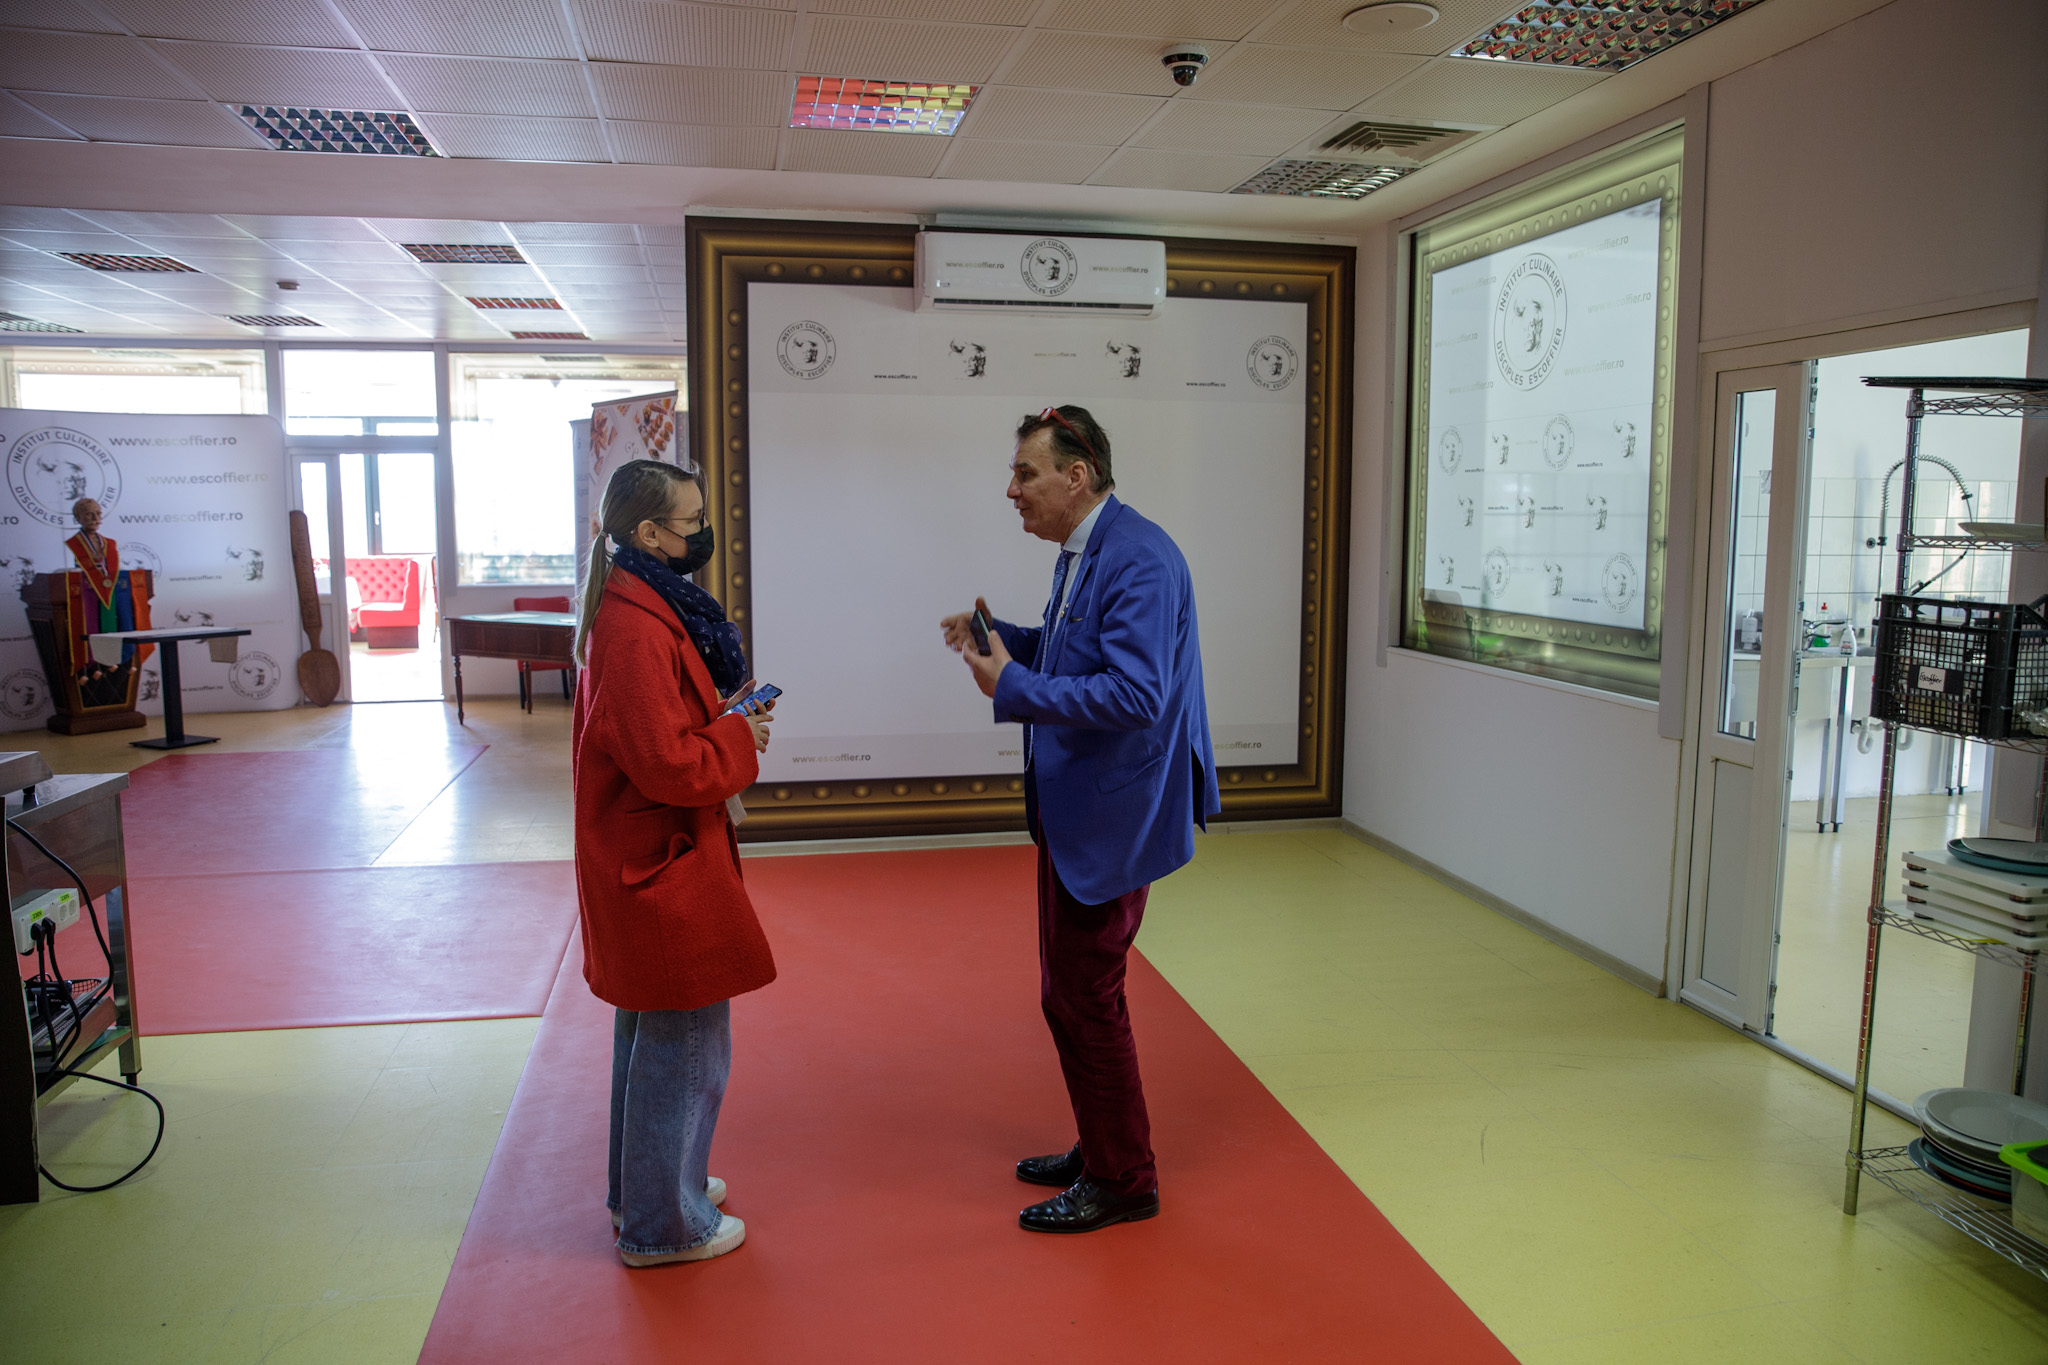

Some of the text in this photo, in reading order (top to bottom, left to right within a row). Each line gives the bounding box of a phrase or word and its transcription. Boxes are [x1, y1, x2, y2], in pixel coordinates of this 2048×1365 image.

[1025, 241, 1074, 261] INSTITUT CULINAIRE
[946, 260, 1005, 270] www.escoffier.ro
[1092, 264, 1149, 274] www.escoffier.ro
[1023, 271, 1074, 294] DISCIPLES ESCOFFIER
[1499, 258, 1563, 312] INSTITUT CULINAIRE
[781, 323, 832, 343] INSTITUT CULINAIRE
[1250, 337, 1294, 357] INSTITUT CULINAIRE
[1496, 327, 1563, 386] DISCIPLES ESCOFFIER
[780, 354, 832, 377] DISCIPLES ESCOFFIER
[1249, 367, 1295, 389] DISCIPLES ESCOFFIER
[12, 431, 112, 467] INSTITUT CULINAIRE
[108, 434, 238, 447] www.escoffier.ro
[146, 471, 270, 485] www.escoffier.ro
[14, 486, 65, 526] DISCIPLES
[118, 510, 244, 524] www.escoffier.ro
[1920, 672, 1942, 685] Escoffier
[792, 753, 872, 764] www.escoffier.ro
